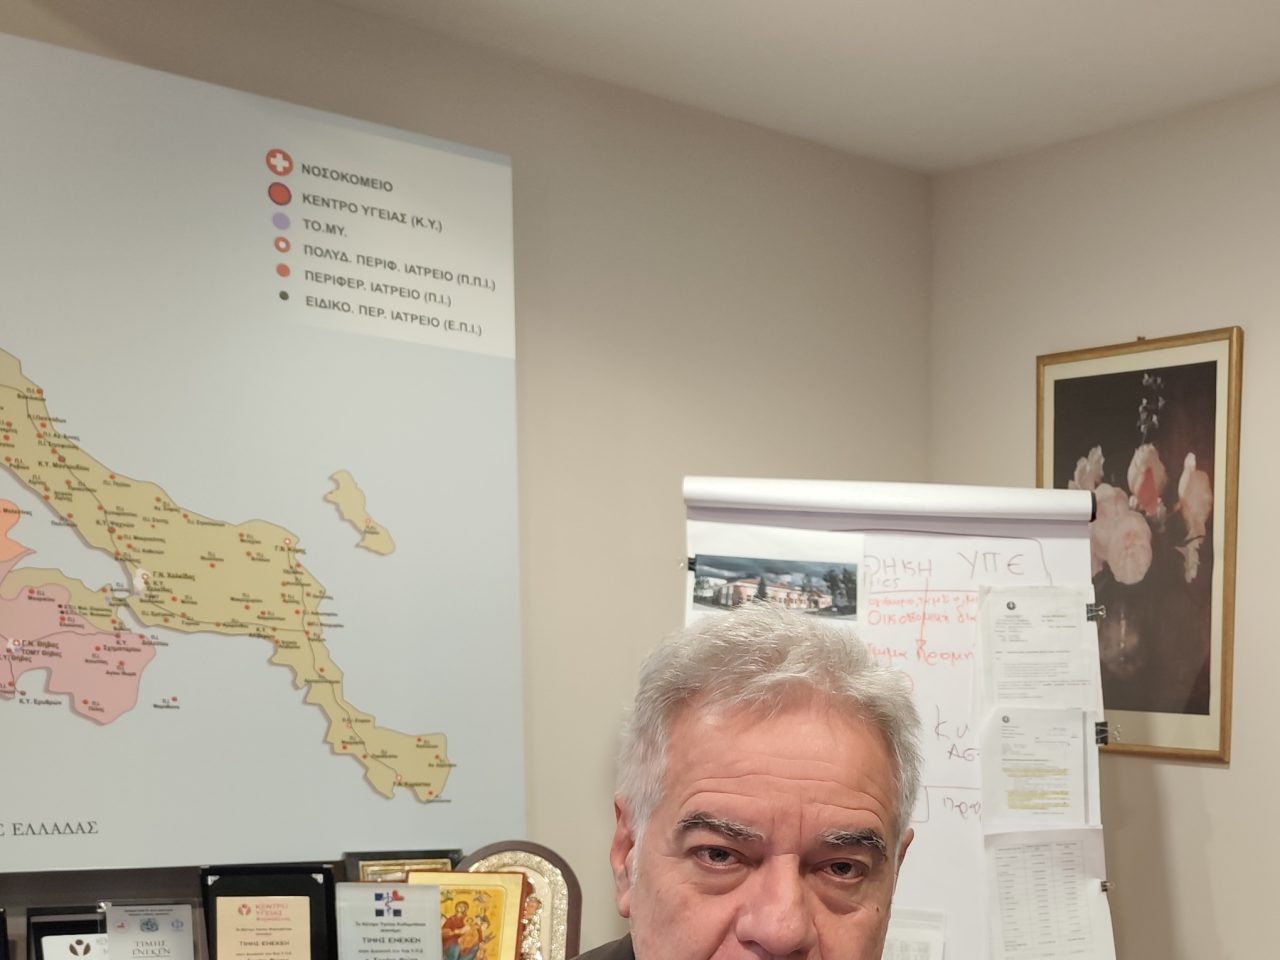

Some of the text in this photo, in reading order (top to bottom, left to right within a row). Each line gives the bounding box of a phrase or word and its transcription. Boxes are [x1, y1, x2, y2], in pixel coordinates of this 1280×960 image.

[301, 163, 393, 192] ΝΟΣΟΚΟΜΕΙΟ
[302, 193, 443, 233] ΚΕΝΤΡΟ ΥΓΕΙΑΣ (Κ.Υ.)
[303, 218, 348, 237] ΤΟ.ΜΥ.
[304, 244, 496, 291] ΠΟΛΥΔ. ΠΕΡΙΦ. ΙΑΤΡΕΙΟ (Π.Π.Ι.)
[305, 270, 452, 307] ΠΕΡΙΦΕΡ. ΙΑΤΡΕΙΟ (Π.Ι.)
[306, 296, 482, 337] ΕΙΔΙΚΟ. ΠΕΡ. ΙΑΤΡΕΙΟ (Ε.Π.Ι.)
[12, 820, 98, 836] ΕΛΛΑΔΑΣ
